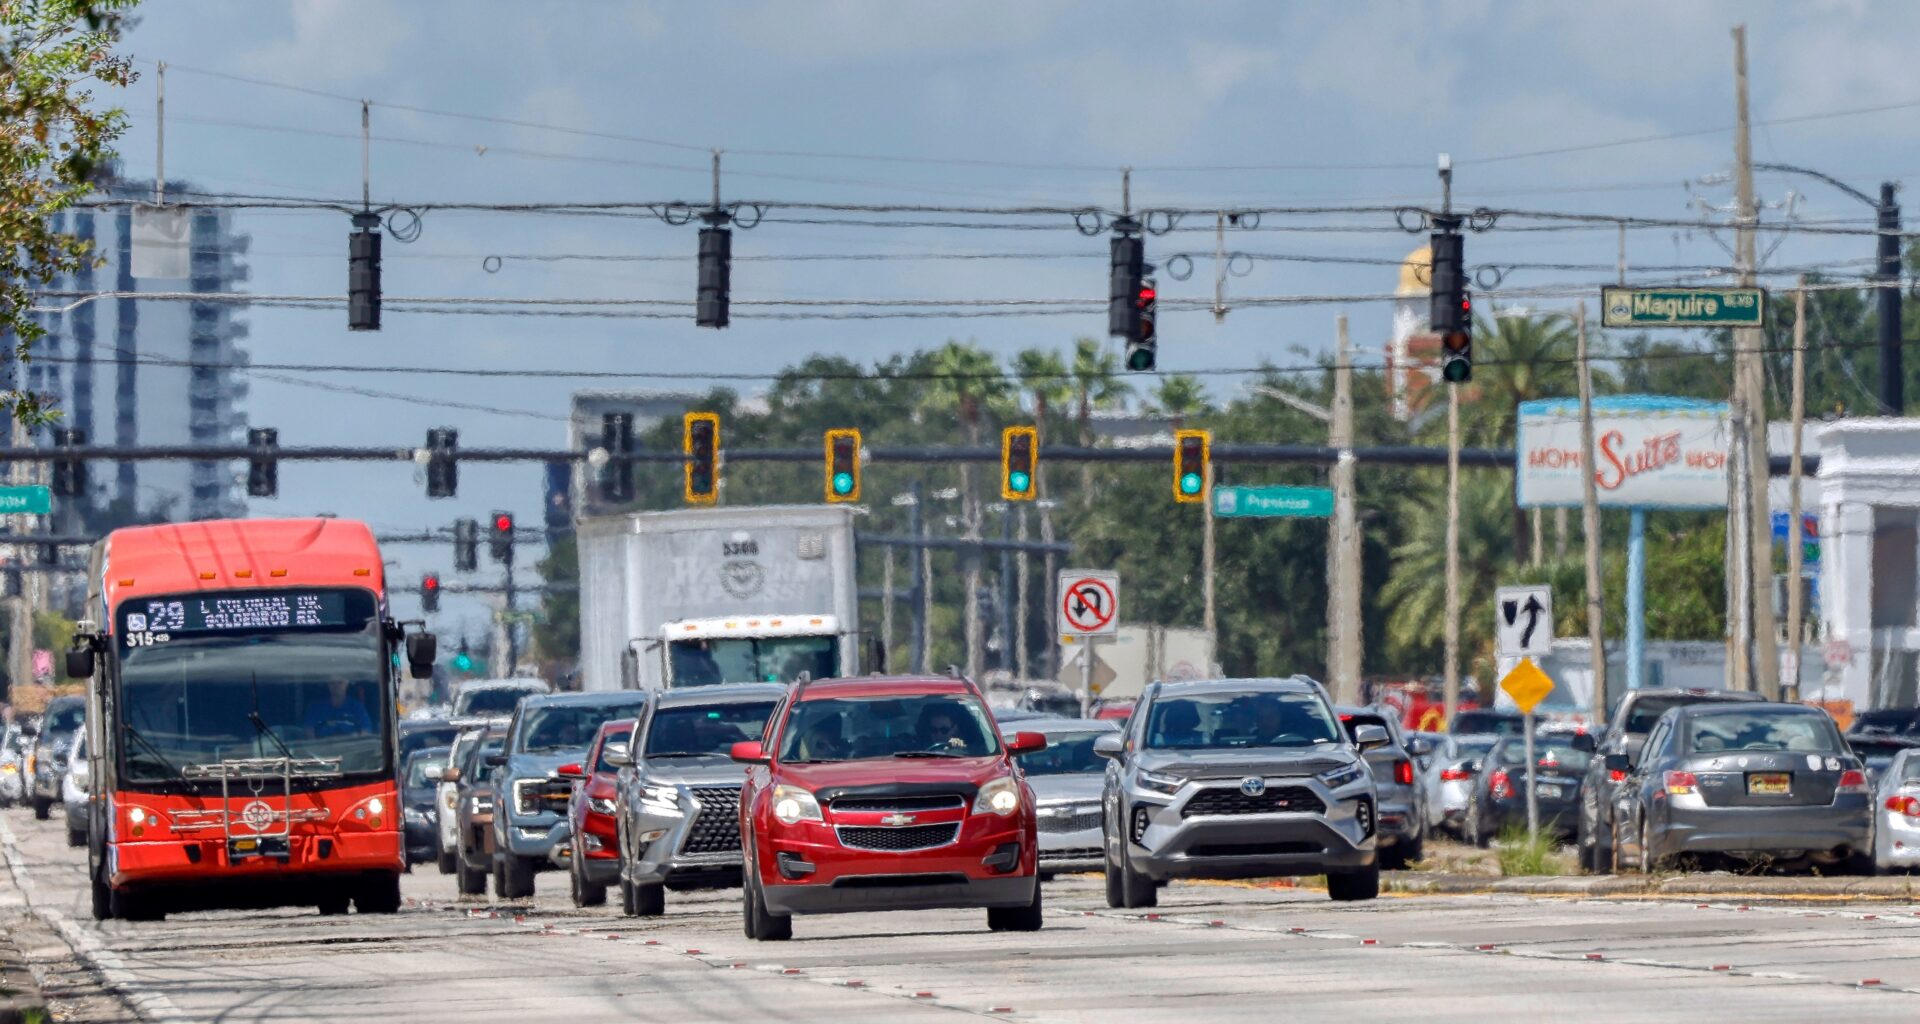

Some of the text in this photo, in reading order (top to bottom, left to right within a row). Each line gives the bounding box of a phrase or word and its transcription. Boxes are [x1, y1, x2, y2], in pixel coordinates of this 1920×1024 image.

[1634, 294, 1718, 322] Maguire
[1595, 429, 1680, 489] Suite
[148, 601, 185, 631] 29
